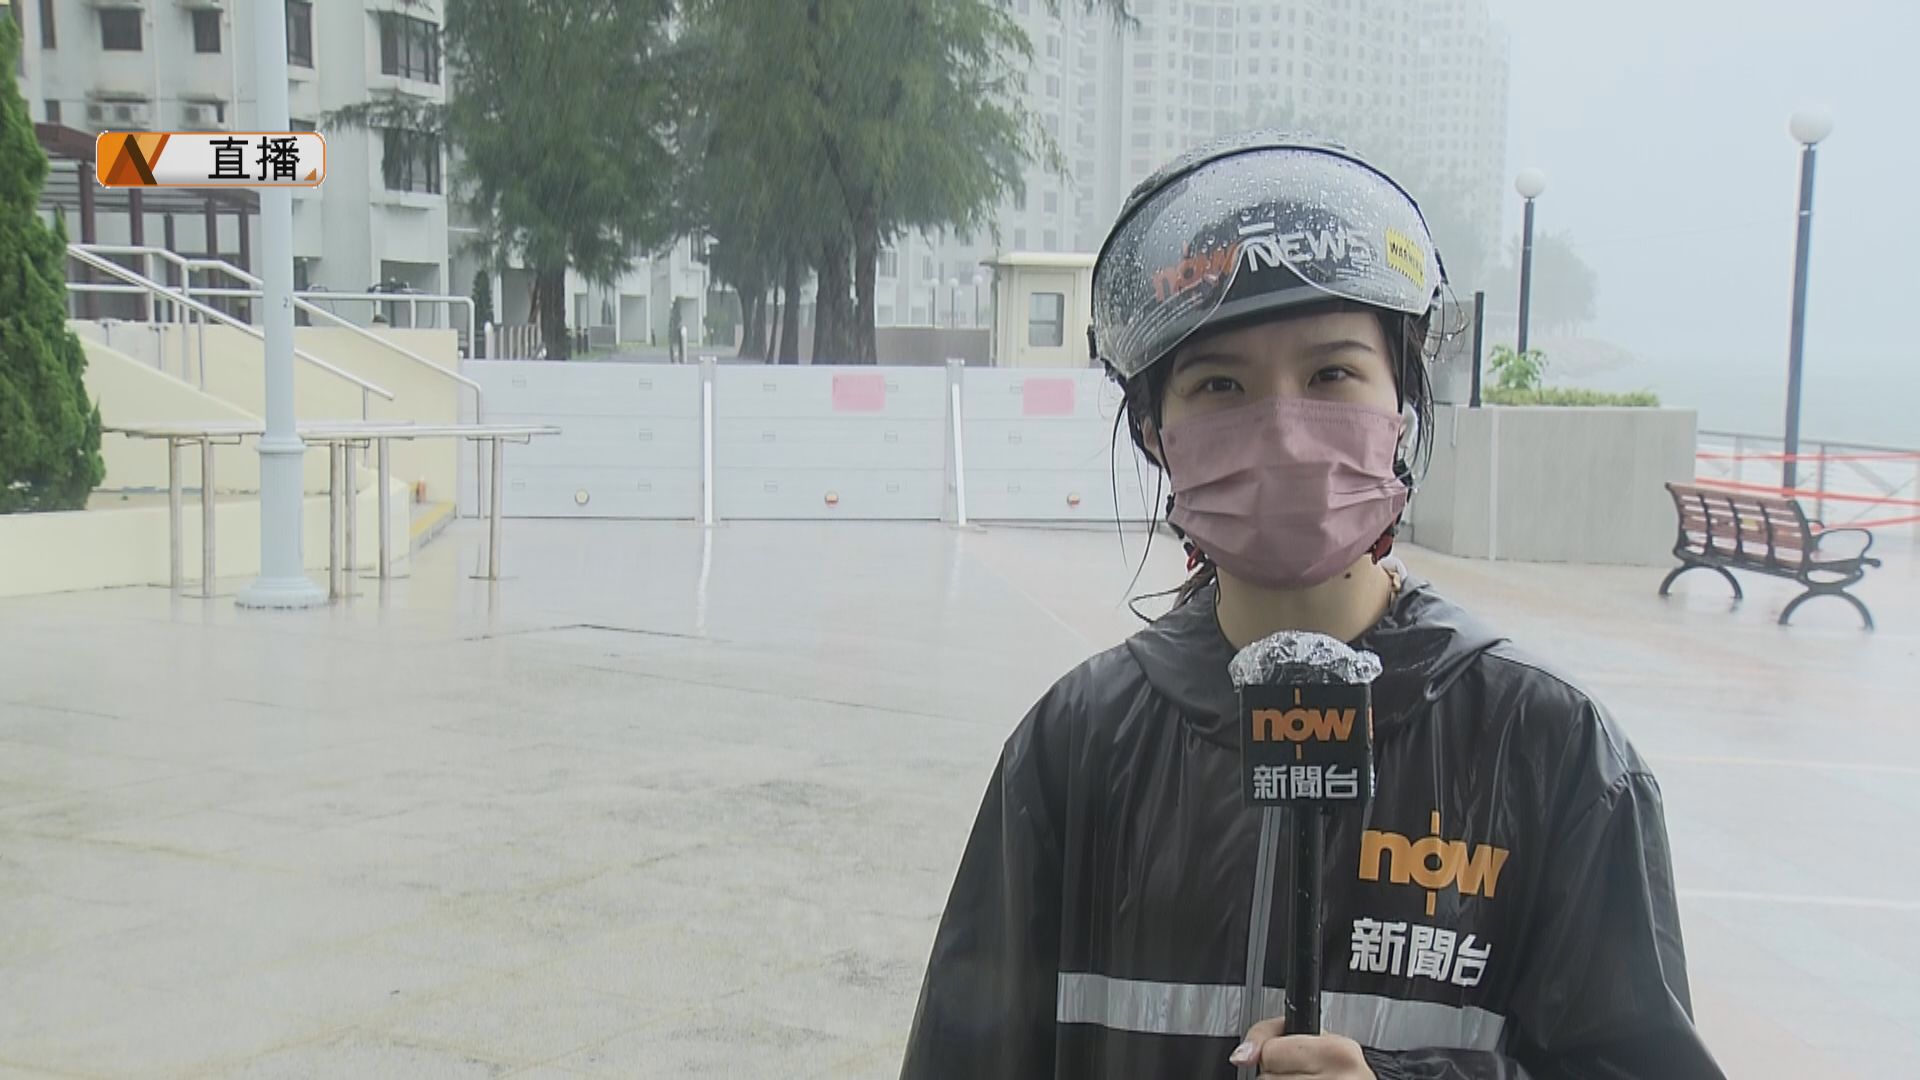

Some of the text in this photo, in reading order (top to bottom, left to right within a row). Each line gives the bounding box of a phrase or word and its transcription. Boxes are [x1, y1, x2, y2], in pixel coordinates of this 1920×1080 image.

[1152, 227, 1372, 303] now NEWS
[1252, 706, 1356, 742] now
[1253, 765, 1358, 800] 新聞台
[1358, 829, 1510, 898] now
[1349, 917, 1492, 987] 新聞台
